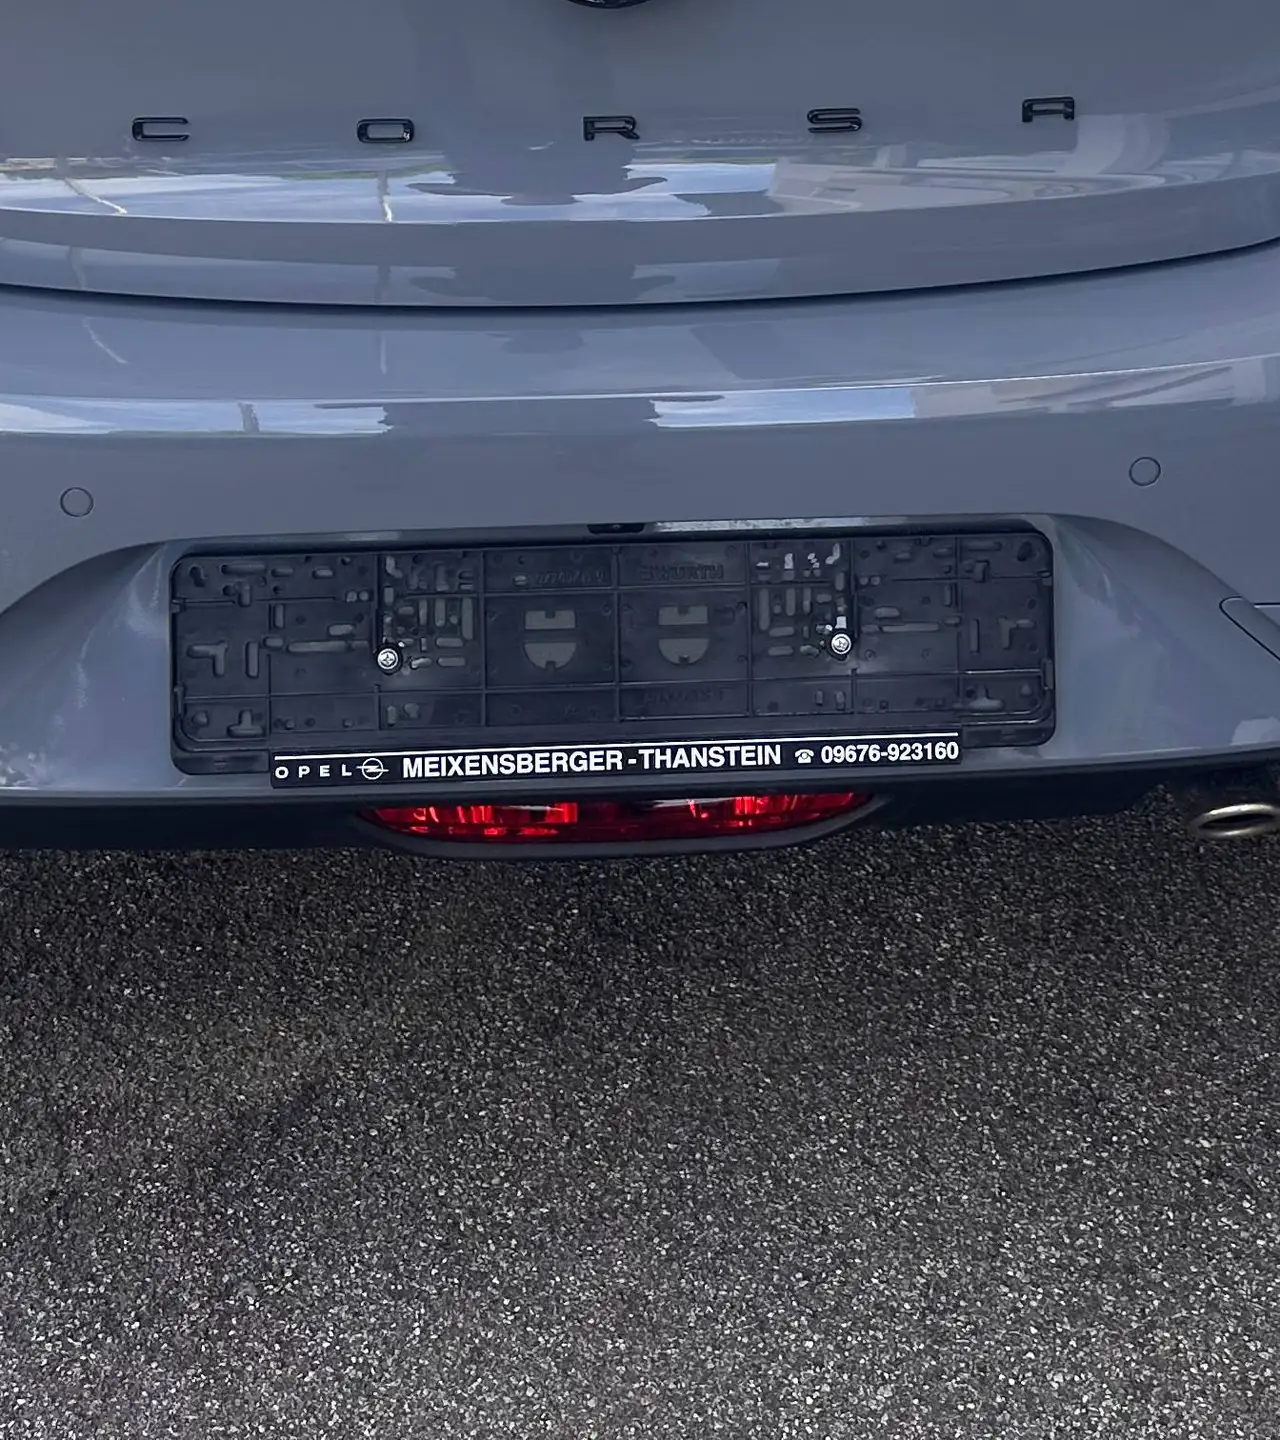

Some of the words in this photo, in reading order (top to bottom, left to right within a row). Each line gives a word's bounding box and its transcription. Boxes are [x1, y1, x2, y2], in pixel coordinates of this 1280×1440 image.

[131, 96, 1075, 144] CORSA
[274, 763, 353, 779] OPEL
[821, 741, 960, 764] 09676-923160
